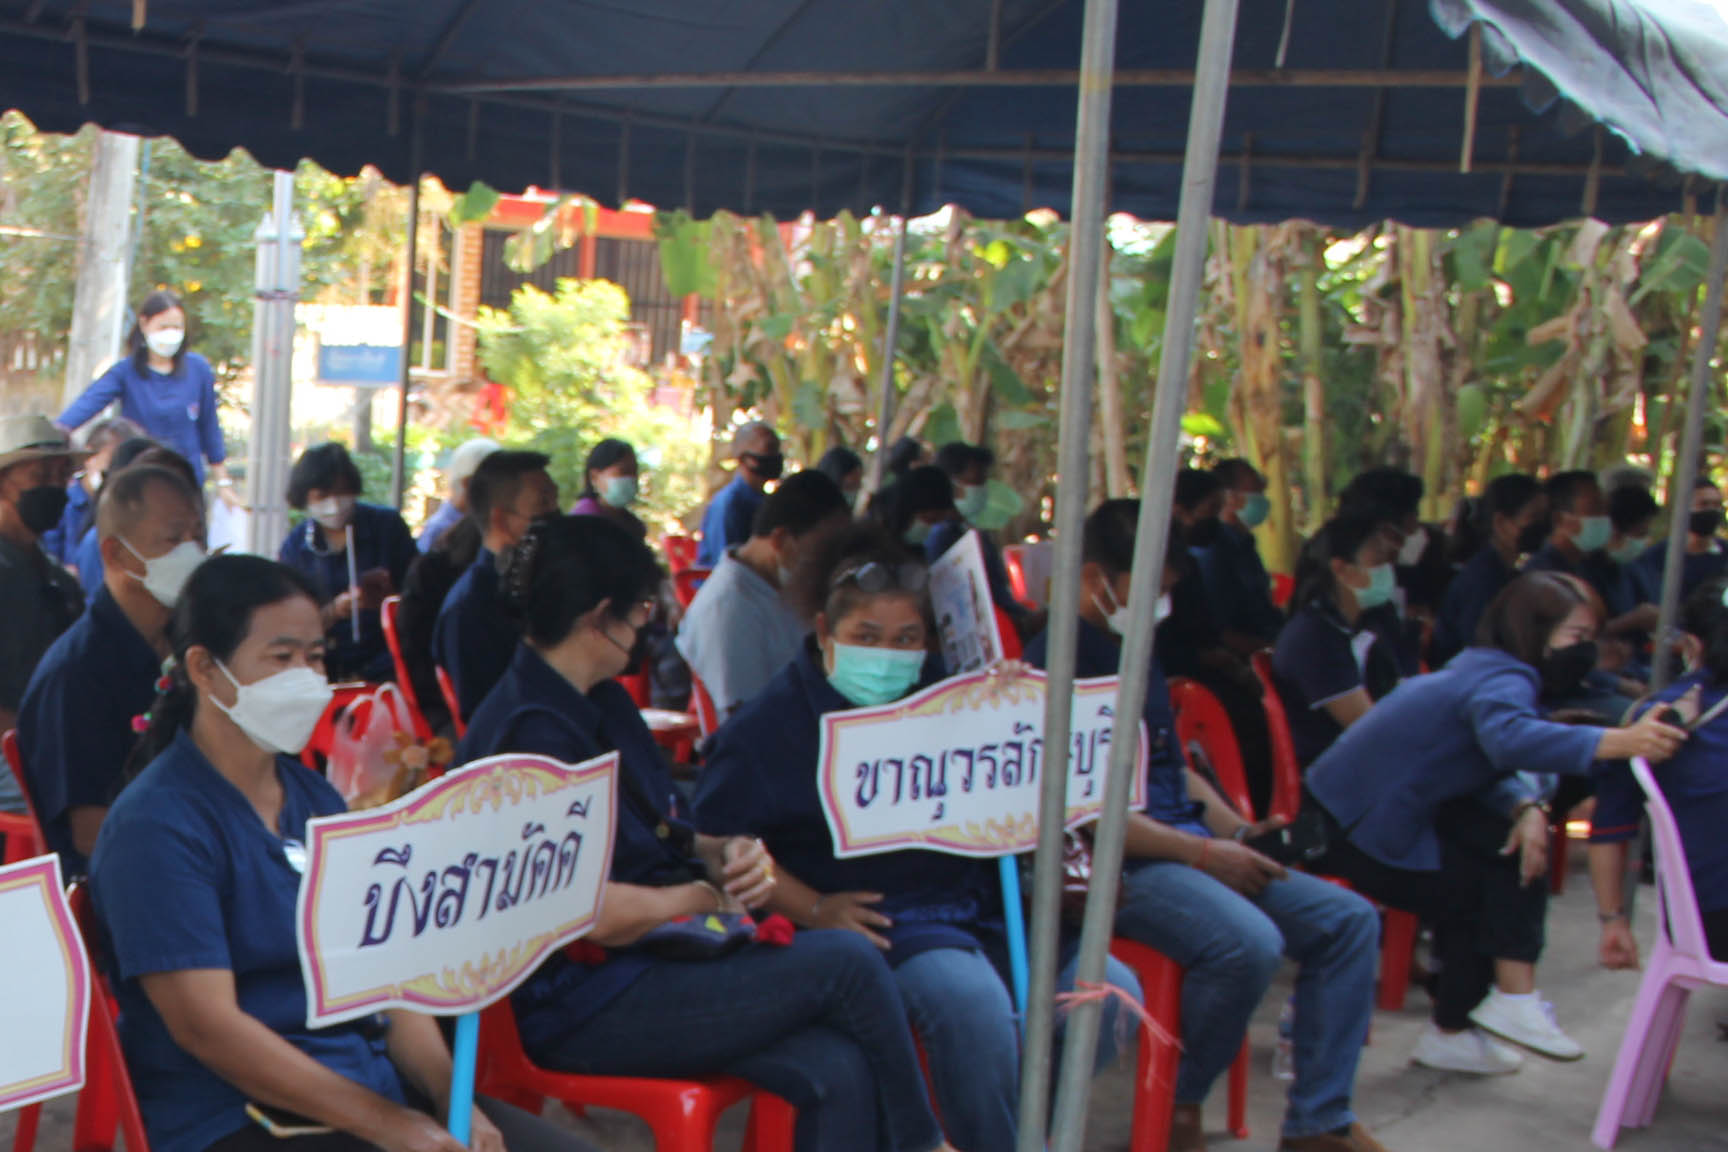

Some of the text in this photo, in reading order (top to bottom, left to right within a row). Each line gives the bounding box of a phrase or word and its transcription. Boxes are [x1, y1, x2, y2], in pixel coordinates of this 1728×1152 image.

[855, 703, 1116, 821] ขาณุวรลักบุ
[358, 795, 592, 949] บึงสามัคคี
